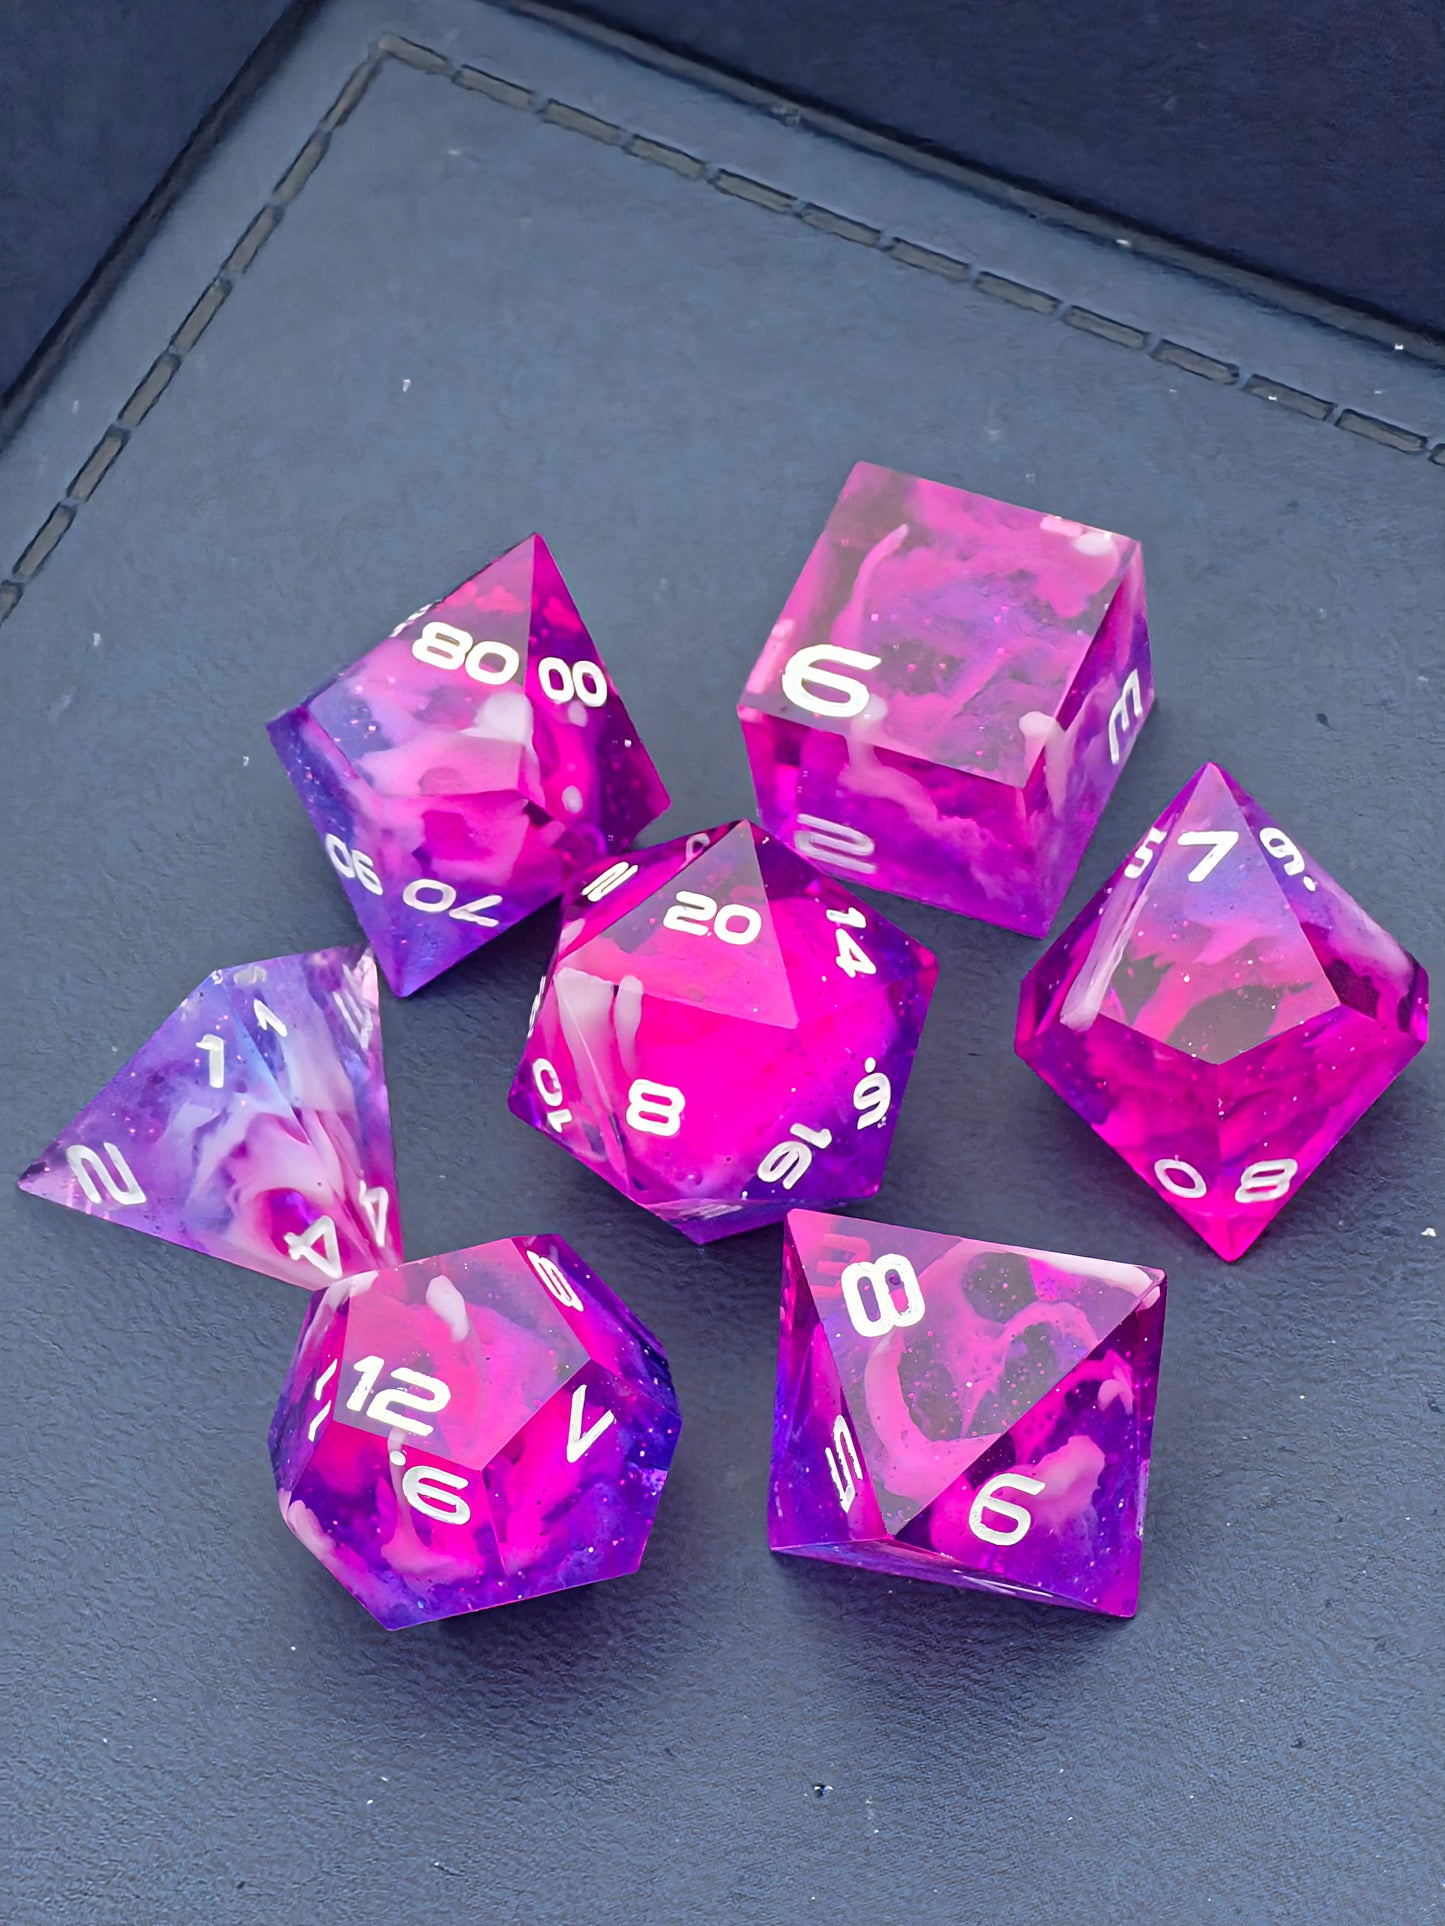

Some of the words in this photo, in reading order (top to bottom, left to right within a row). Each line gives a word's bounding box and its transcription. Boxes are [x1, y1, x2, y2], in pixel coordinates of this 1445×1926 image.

[412, 621, 520, 685] 80
[538, 658, 608, 708] 00
[782, 640, 882, 718] 6
[1108, 669, 1144, 765] 3
[1123, 827, 1167, 880] 5
[1177, 830, 1239, 883] 7
[402, 878, 504, 928] 70
[662, 890, 762, 946] 20
[825, 906, 877, 978] 14
[195, 1034, 225, 1089] 1
[626, 1078, 686, 1137] 8
[66, 1142, 147, 1205] 2
[1154, 1159, 1207, 1199] 0
[1235, 1158, 1298, 1204] 8
[284, 1215, 343, 1280] 4
[840, 1253, 926, 1338] 8
[345, 1354, 452, 1437] 12
[565, 1383, 616, 1464] 7
[968, 1472, 1047, 1547] 6
